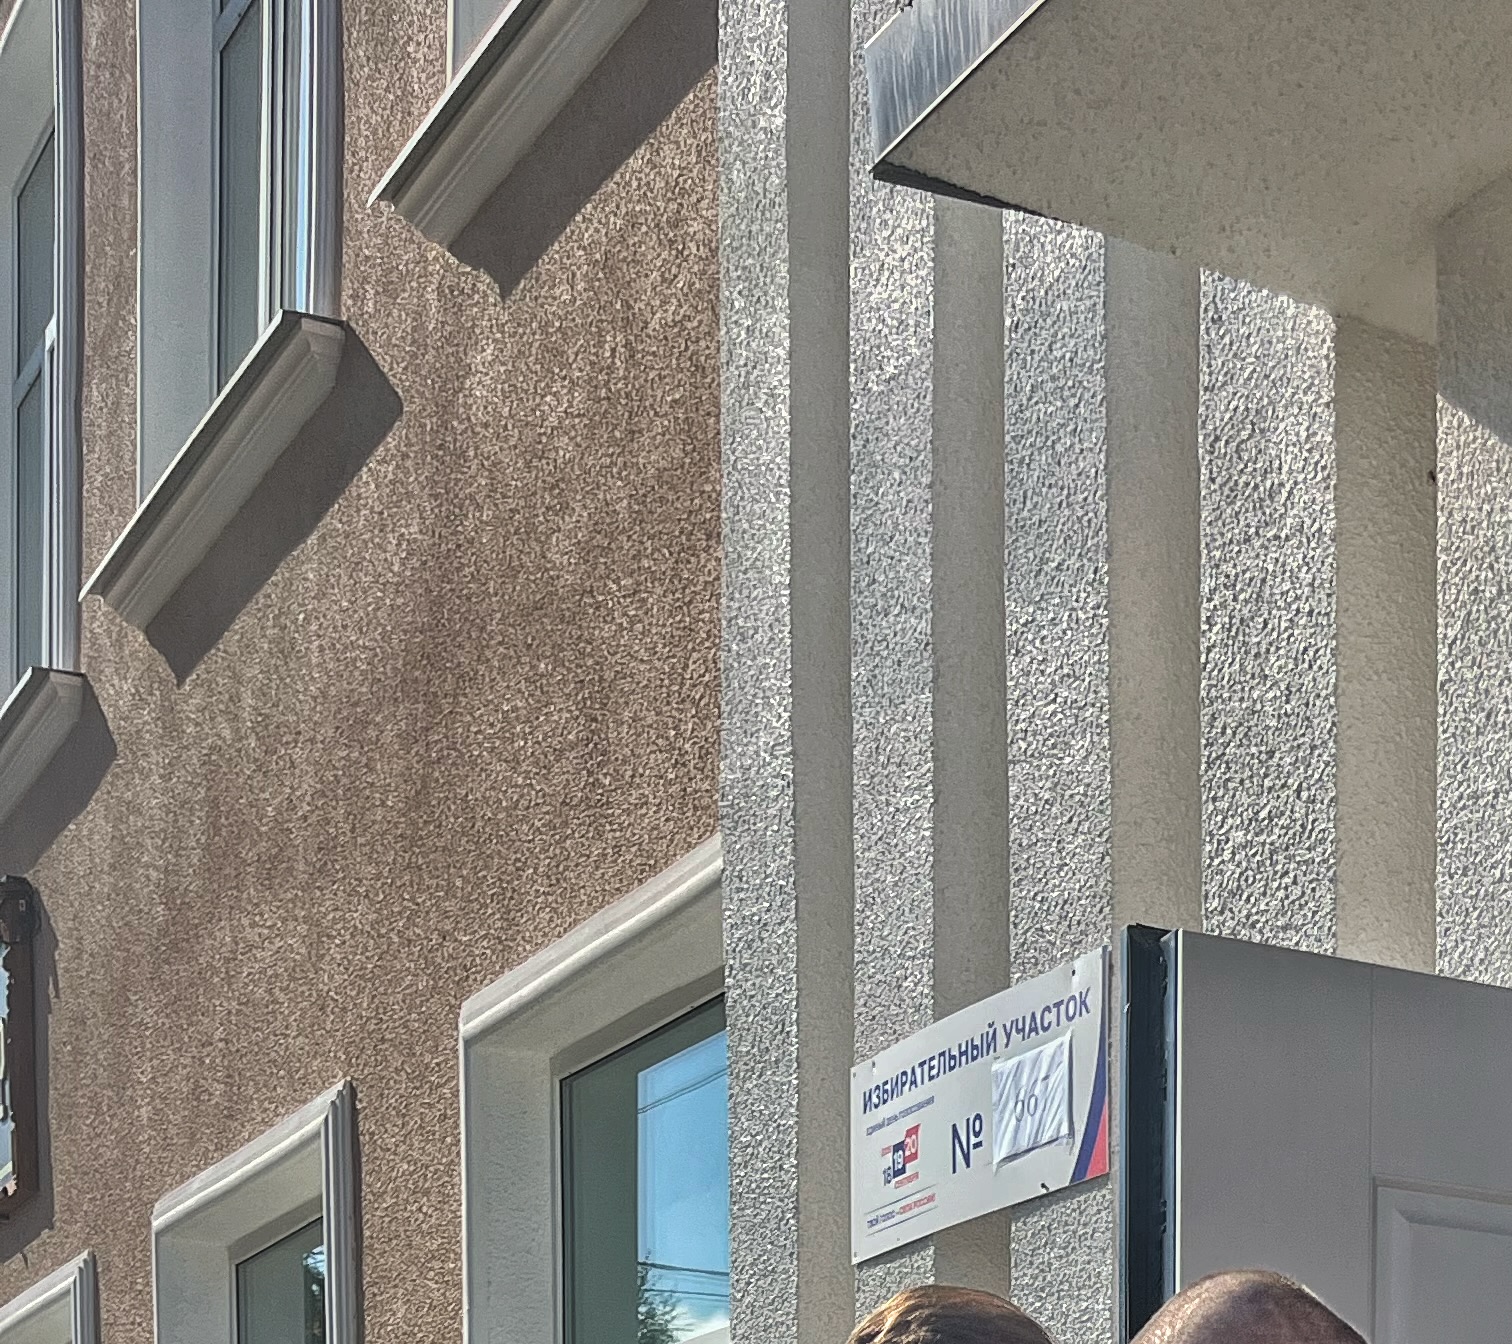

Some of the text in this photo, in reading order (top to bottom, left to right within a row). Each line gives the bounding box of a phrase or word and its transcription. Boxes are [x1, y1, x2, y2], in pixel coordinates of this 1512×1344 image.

[862, 986, 1091, 1115] ИЗБИРАТЕЛЬНЫЙ УЧАСТОК
[904, 1134, 917, 1157] 20
[951, 1112, 983, 1175] №
